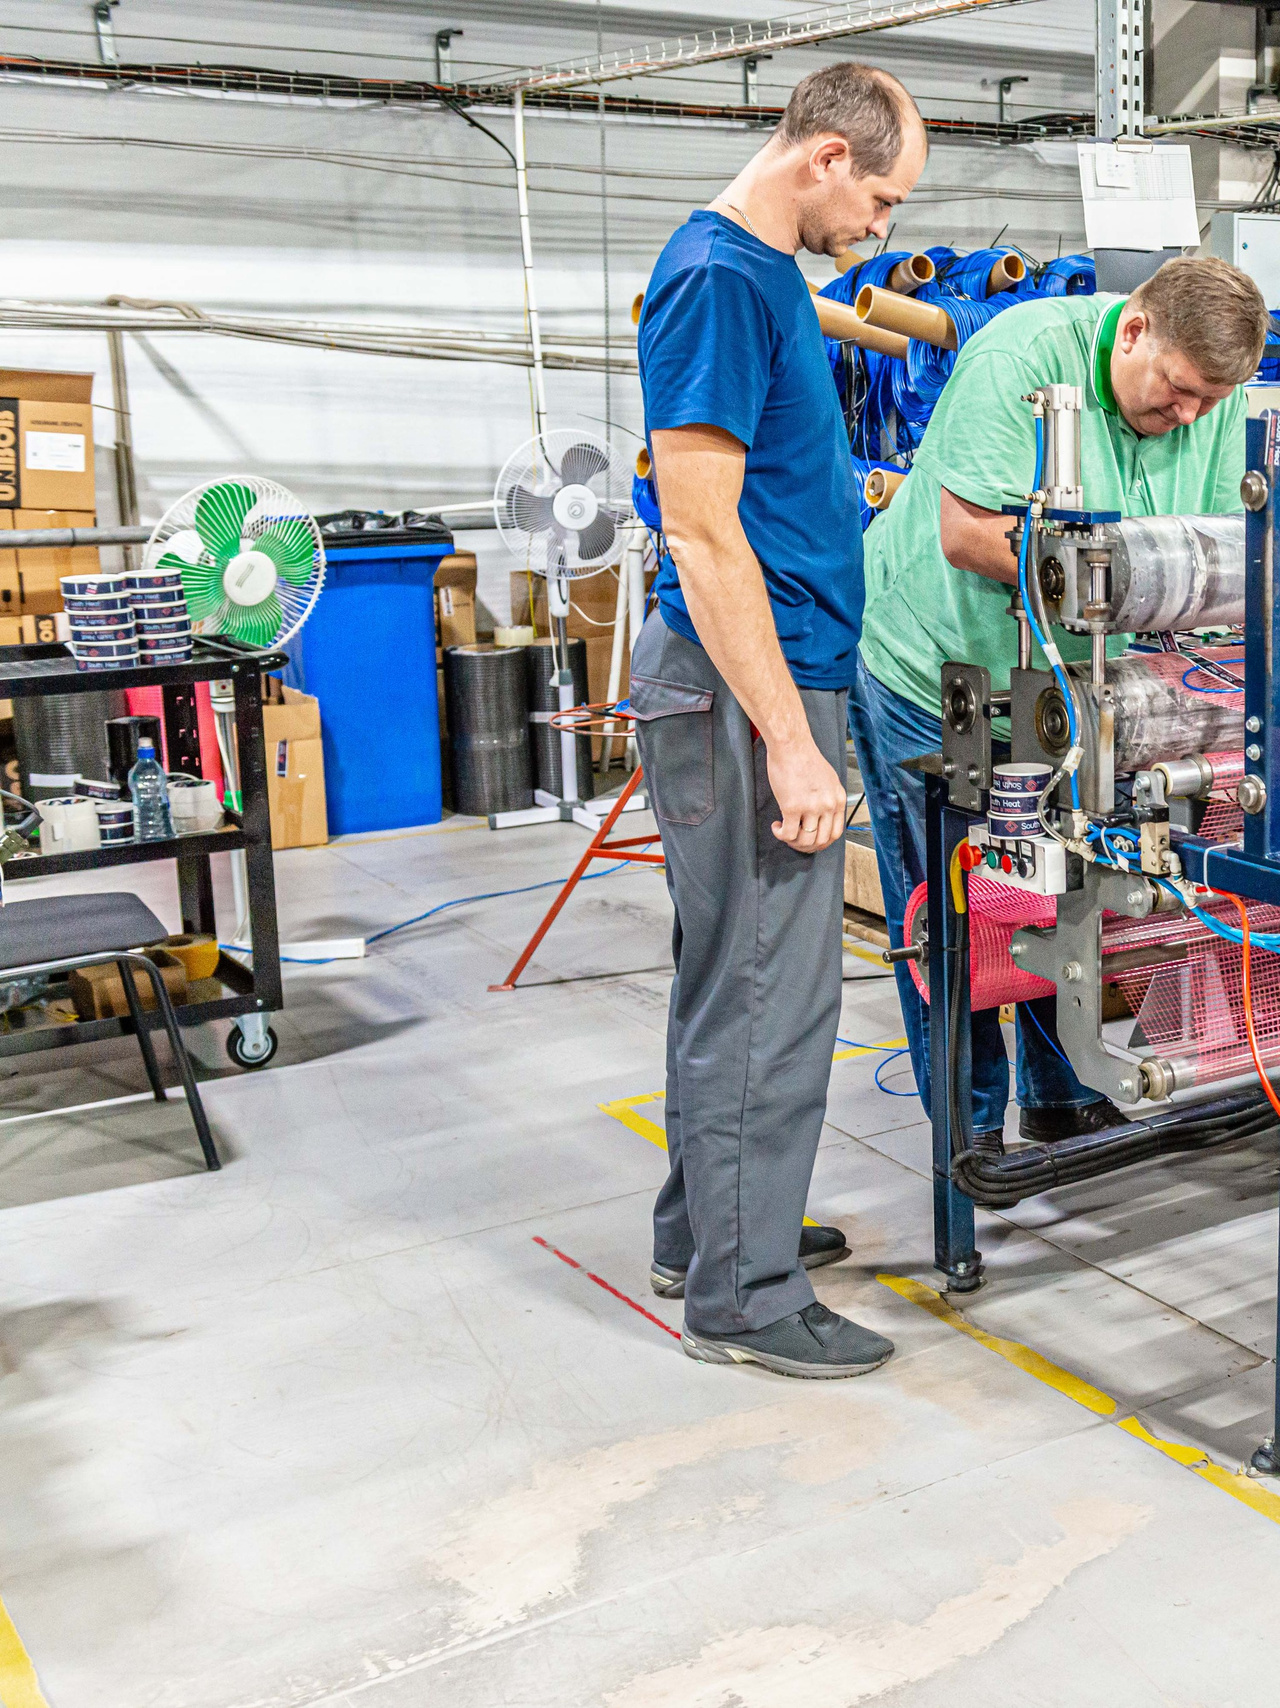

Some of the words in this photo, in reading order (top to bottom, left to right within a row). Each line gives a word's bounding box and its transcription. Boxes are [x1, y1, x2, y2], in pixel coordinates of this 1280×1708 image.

[1002, 781, 1022, 790] South
[1003, 800, 1021, 808] Heat
[1021, 820, 1040, 830] South
